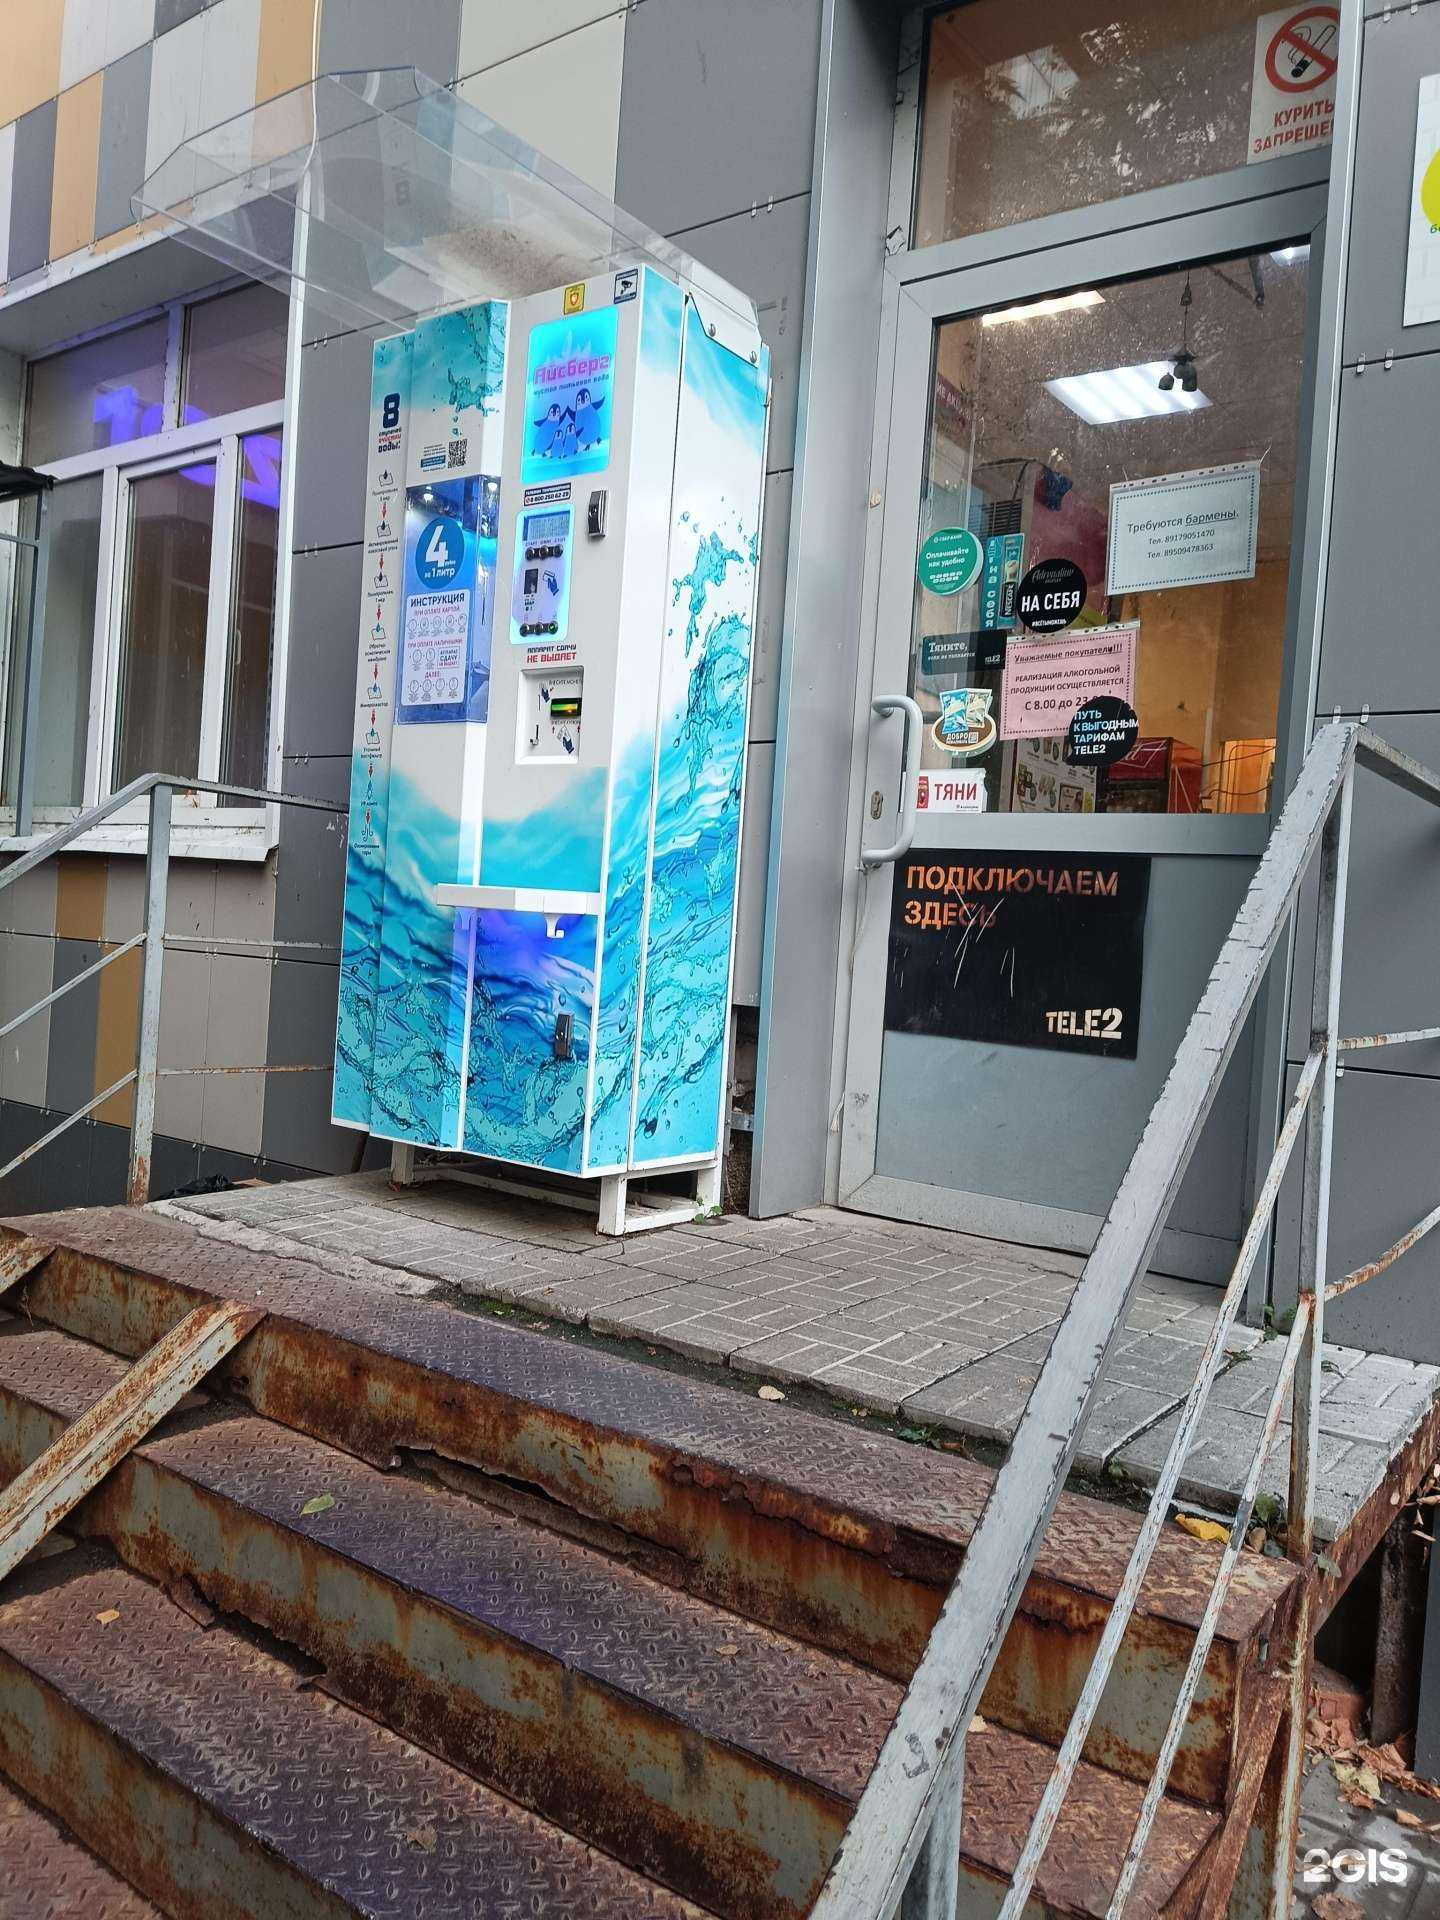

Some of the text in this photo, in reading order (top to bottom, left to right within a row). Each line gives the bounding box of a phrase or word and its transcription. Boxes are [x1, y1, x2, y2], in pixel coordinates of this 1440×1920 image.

[1274, 99, 1334, 127] КУРИТЬ
[1253, 118, 1334, 154] ЗАПРЕЩЕ
[383, 392, 401, 429] 8
[1128, 518, 1184, 535] Требуются
[425, 525, 449, 568] 4
[926, 547, 969, 560] Оплачивайте
[941, 557, 965, 568] удобно
[436, 567, 456, 579] литр
[411, 593, 465, 608] ИНСТРУКЦИЯ
[1021, 590, 1081, 613] НА СЕБЯ
[527, 652, 577, 663] НЕ ВЫДАЕТ
[1014, 651, 1062, 665] Уважаемые
[1015, 664, 1120, 682] РЕАЛИЗАЦИЯ АЛКОГОЛЬНОЙ
[1010, 677, 1124, 695] ПРОДУКЦИИ ОСУЩЕСТВЛЯЕТСЯ
[1025, 701, 1031, 710] С
[1034, 699, 1056, 710] 8.00
[1058, 698, 1072, 710] до
[1074, 709, 1102, 720] ПУТЬ
[1073, 718, 1139, 732] К ВЫГОДНЫМ
[946, 732, 968, 742] ДОБРО
[1074, 731, 1125, 743] ТАРИФАМ
[1074, 744, 1106, 755] TELE2
[935, 783, 977, 801] ТЯНИ
[906, 866, 1118, 896] ПОДКЛЮЧАЕМ
[904, 900, 997, 930] ЗДЕСЬ
[1045, 1007, 1123, 1040] TELE2
